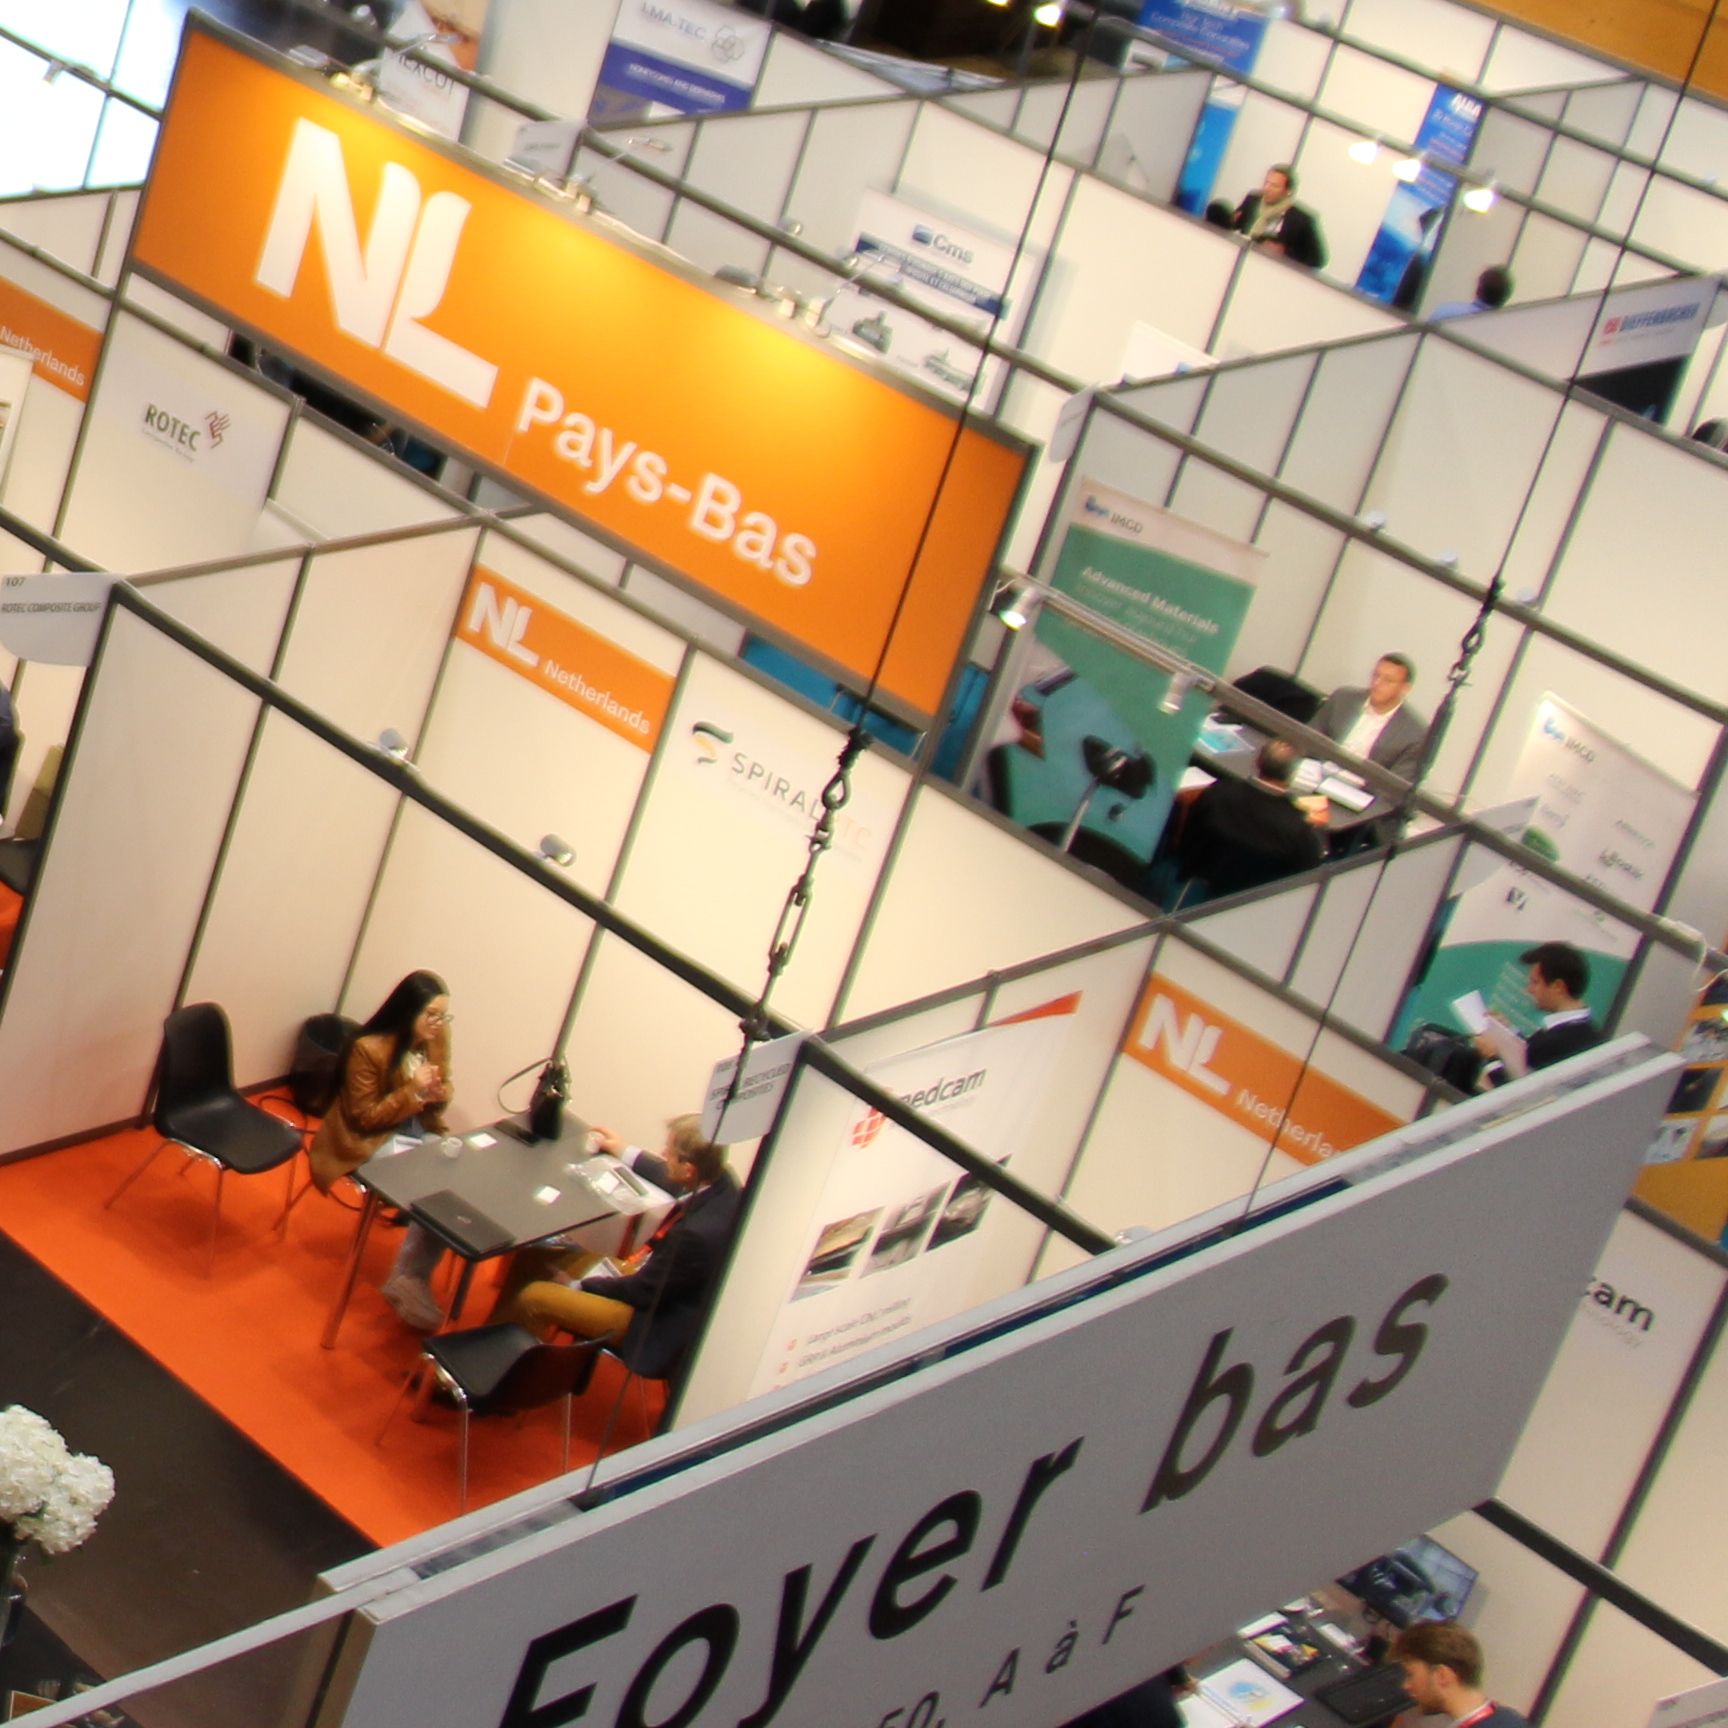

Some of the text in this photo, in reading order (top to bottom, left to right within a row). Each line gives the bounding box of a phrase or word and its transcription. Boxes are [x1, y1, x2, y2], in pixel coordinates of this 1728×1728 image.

[933, 233, 975, 265] Cms
[0, 326, 85, 387] Netherlands
[254, 116, 817, 586] NL Pays-Bas
[144, 403, 201, 452] ROTEC
[1110, 512, 1143, 534] IMCD
[1, 600, 102, 615] ROTEC COMPOSITE GROUP
[5, 576, 26, 588] 107
[1082, 565, 1152, 603] Advanced
[1152, 596, 1220, 636] Materials
[467, 581, 651, 736] NL Netherlands
[1139, 992, 1232, 1097] NL
[502, 1272, 1449, 1728] Foyer bas
[978, 1647, 1021, 1709] A
[1099, 1583, 1146, 1645] F
